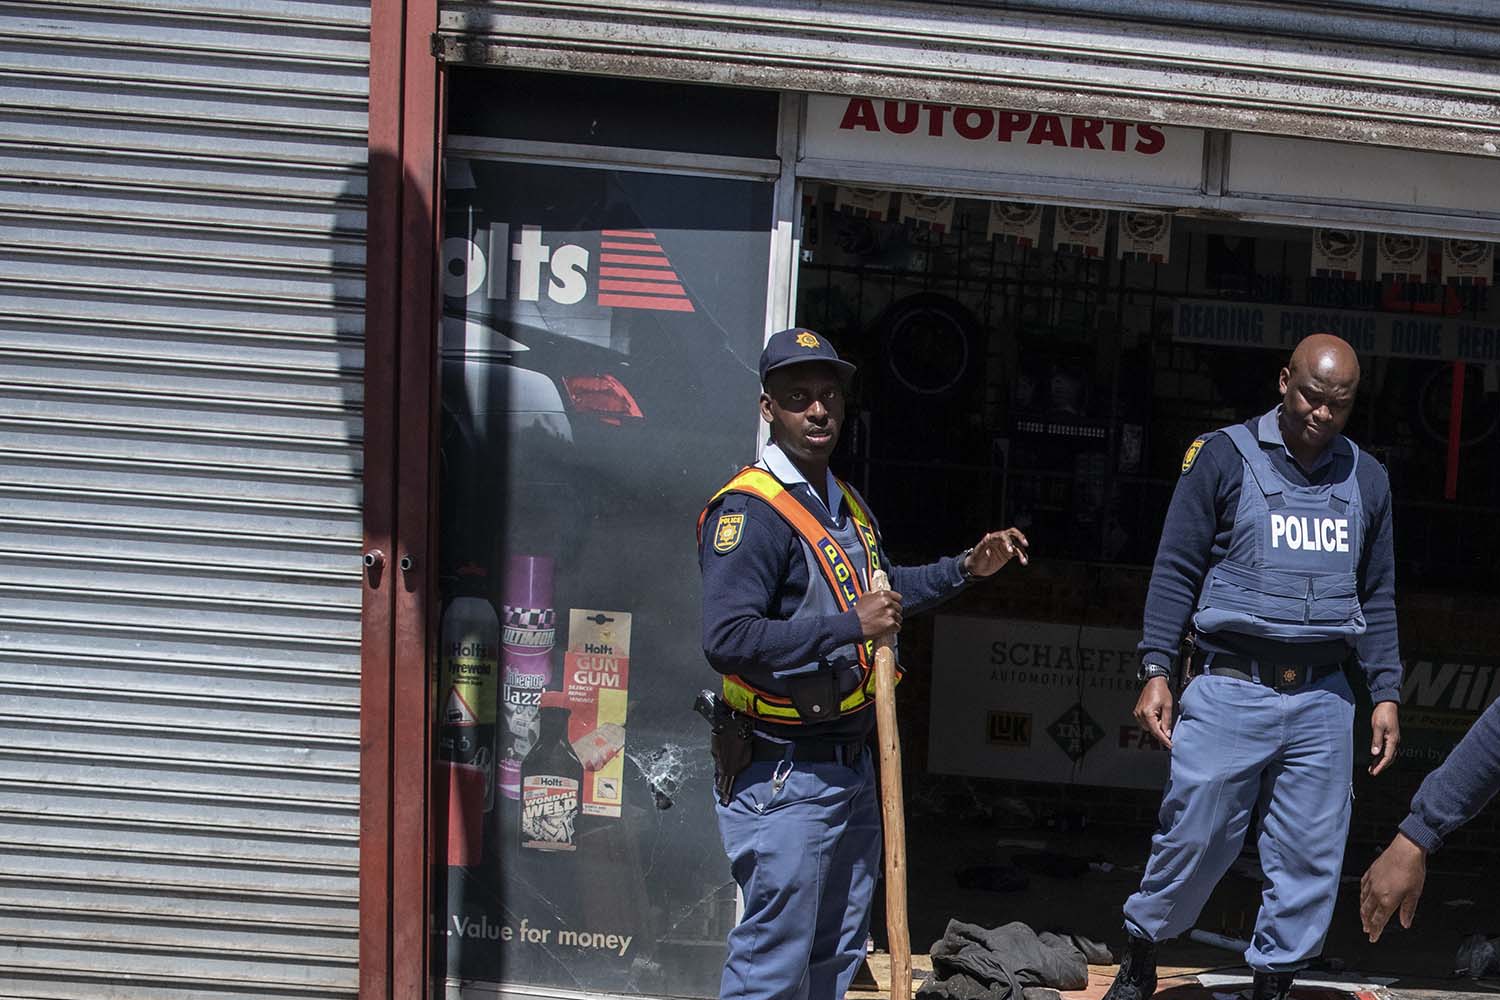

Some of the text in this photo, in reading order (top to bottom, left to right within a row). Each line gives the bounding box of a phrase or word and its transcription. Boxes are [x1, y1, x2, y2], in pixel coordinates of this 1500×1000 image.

[839, 97, 1166, 155] AUTOPARTS
[1271, 514, 1349, 553] POLICE
[585, 643, 613, 655] Holts
[576, 656, 618, 673] GUN
[573, 671, 620, 688] GUM
[541, 777, 563, 787] Holts
[525, 791, 577, 807] WONDAR
[525, 799, 577, 819] WELD
[519, 918, 551, 944] for
[558, 929, 633, 957] money
